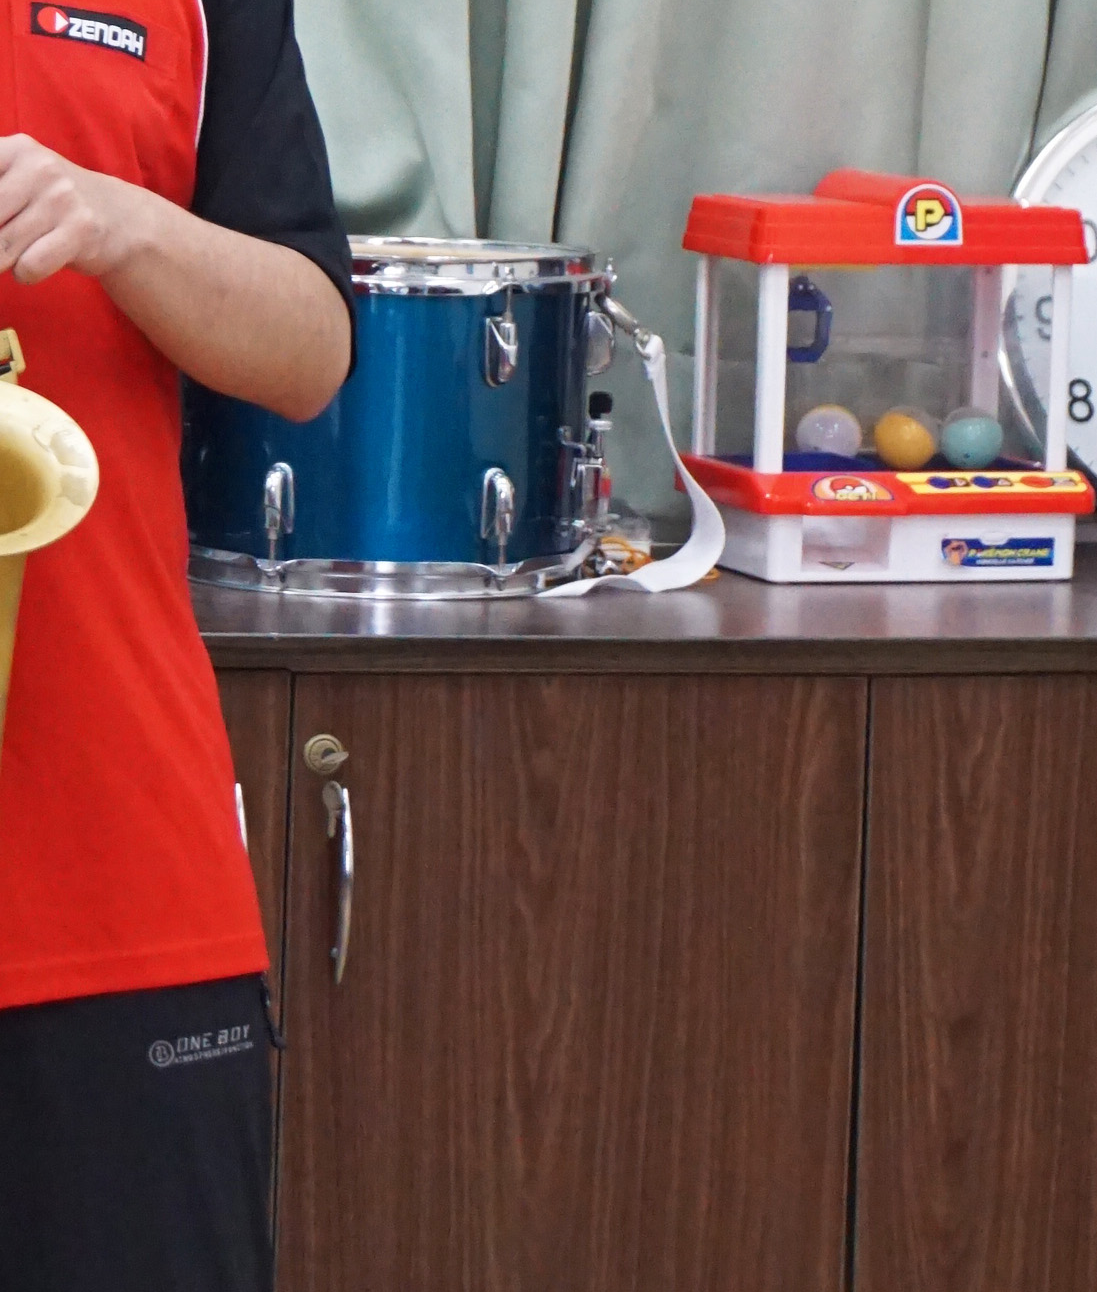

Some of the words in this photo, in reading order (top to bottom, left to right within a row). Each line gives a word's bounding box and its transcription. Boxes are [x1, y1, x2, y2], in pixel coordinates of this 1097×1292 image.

[68, 17, 145, 56] ZENOAH
[916, 199, 945, 231] P
[1068, 378, 1094, 423] 8
[177, 1032, 212, 1053] ONE
[217, 1024, 250, 1044] BOY
